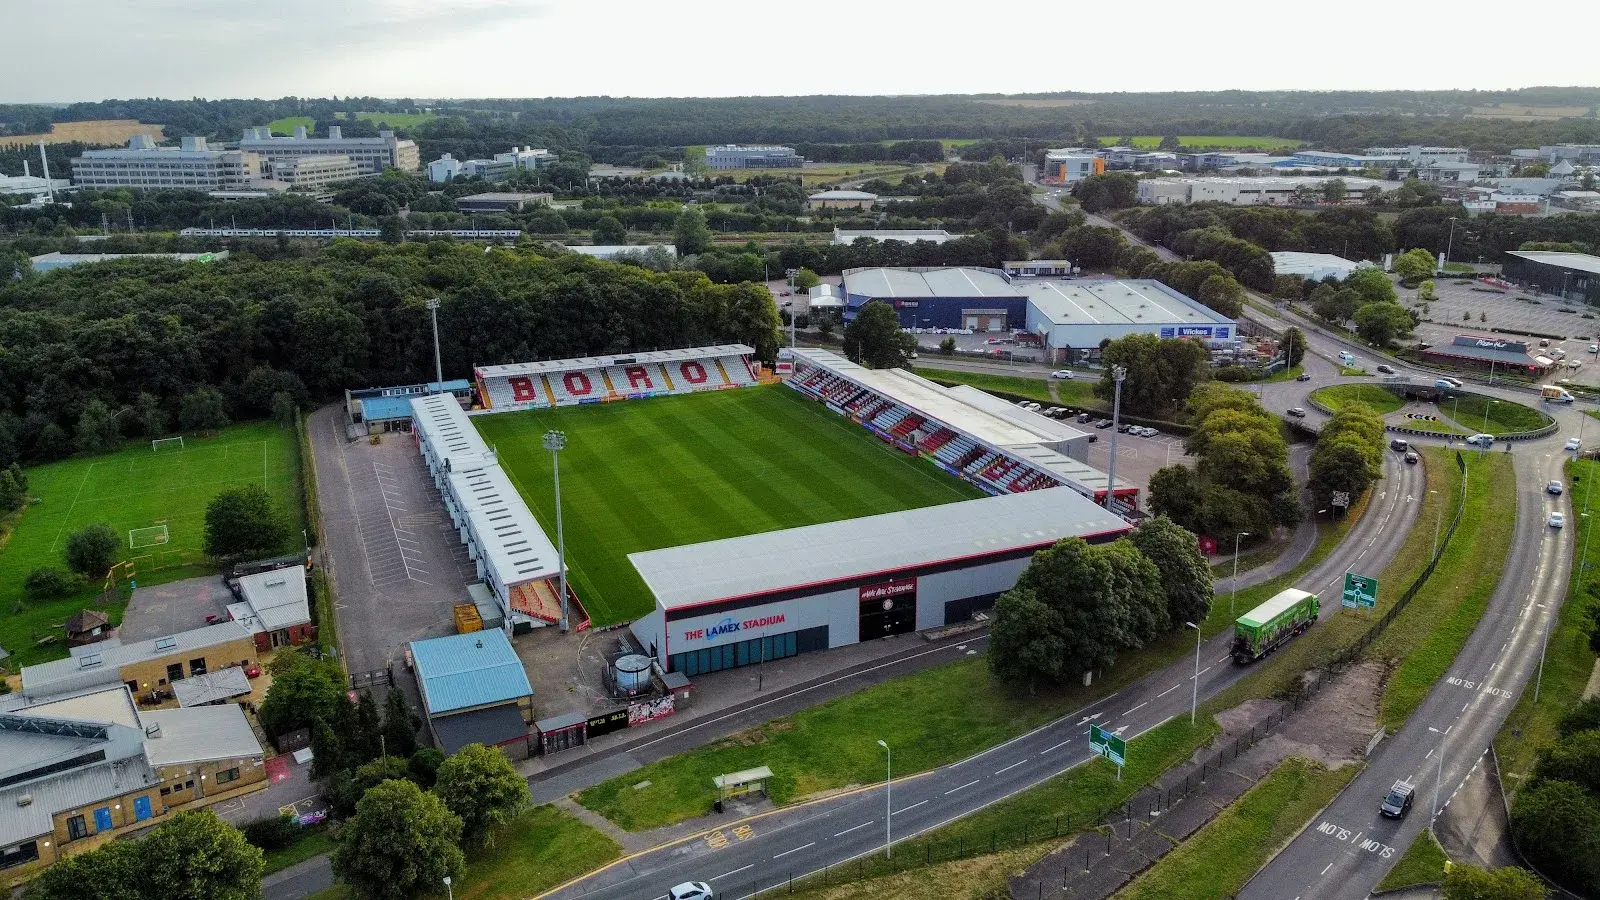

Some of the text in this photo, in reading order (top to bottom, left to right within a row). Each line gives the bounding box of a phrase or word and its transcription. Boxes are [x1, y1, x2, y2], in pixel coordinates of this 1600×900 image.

[508, 361, 709, 402] BORO
[684, 614, 785, 640] THE LAMEX STADIUM
[1446, 676, 1475, 689] SLOW
[1483, 686, 1513, 699] SLOW
[1317, 821, 1351, 840] SLOW
[1359, 838, 1396, 858] SLOW
